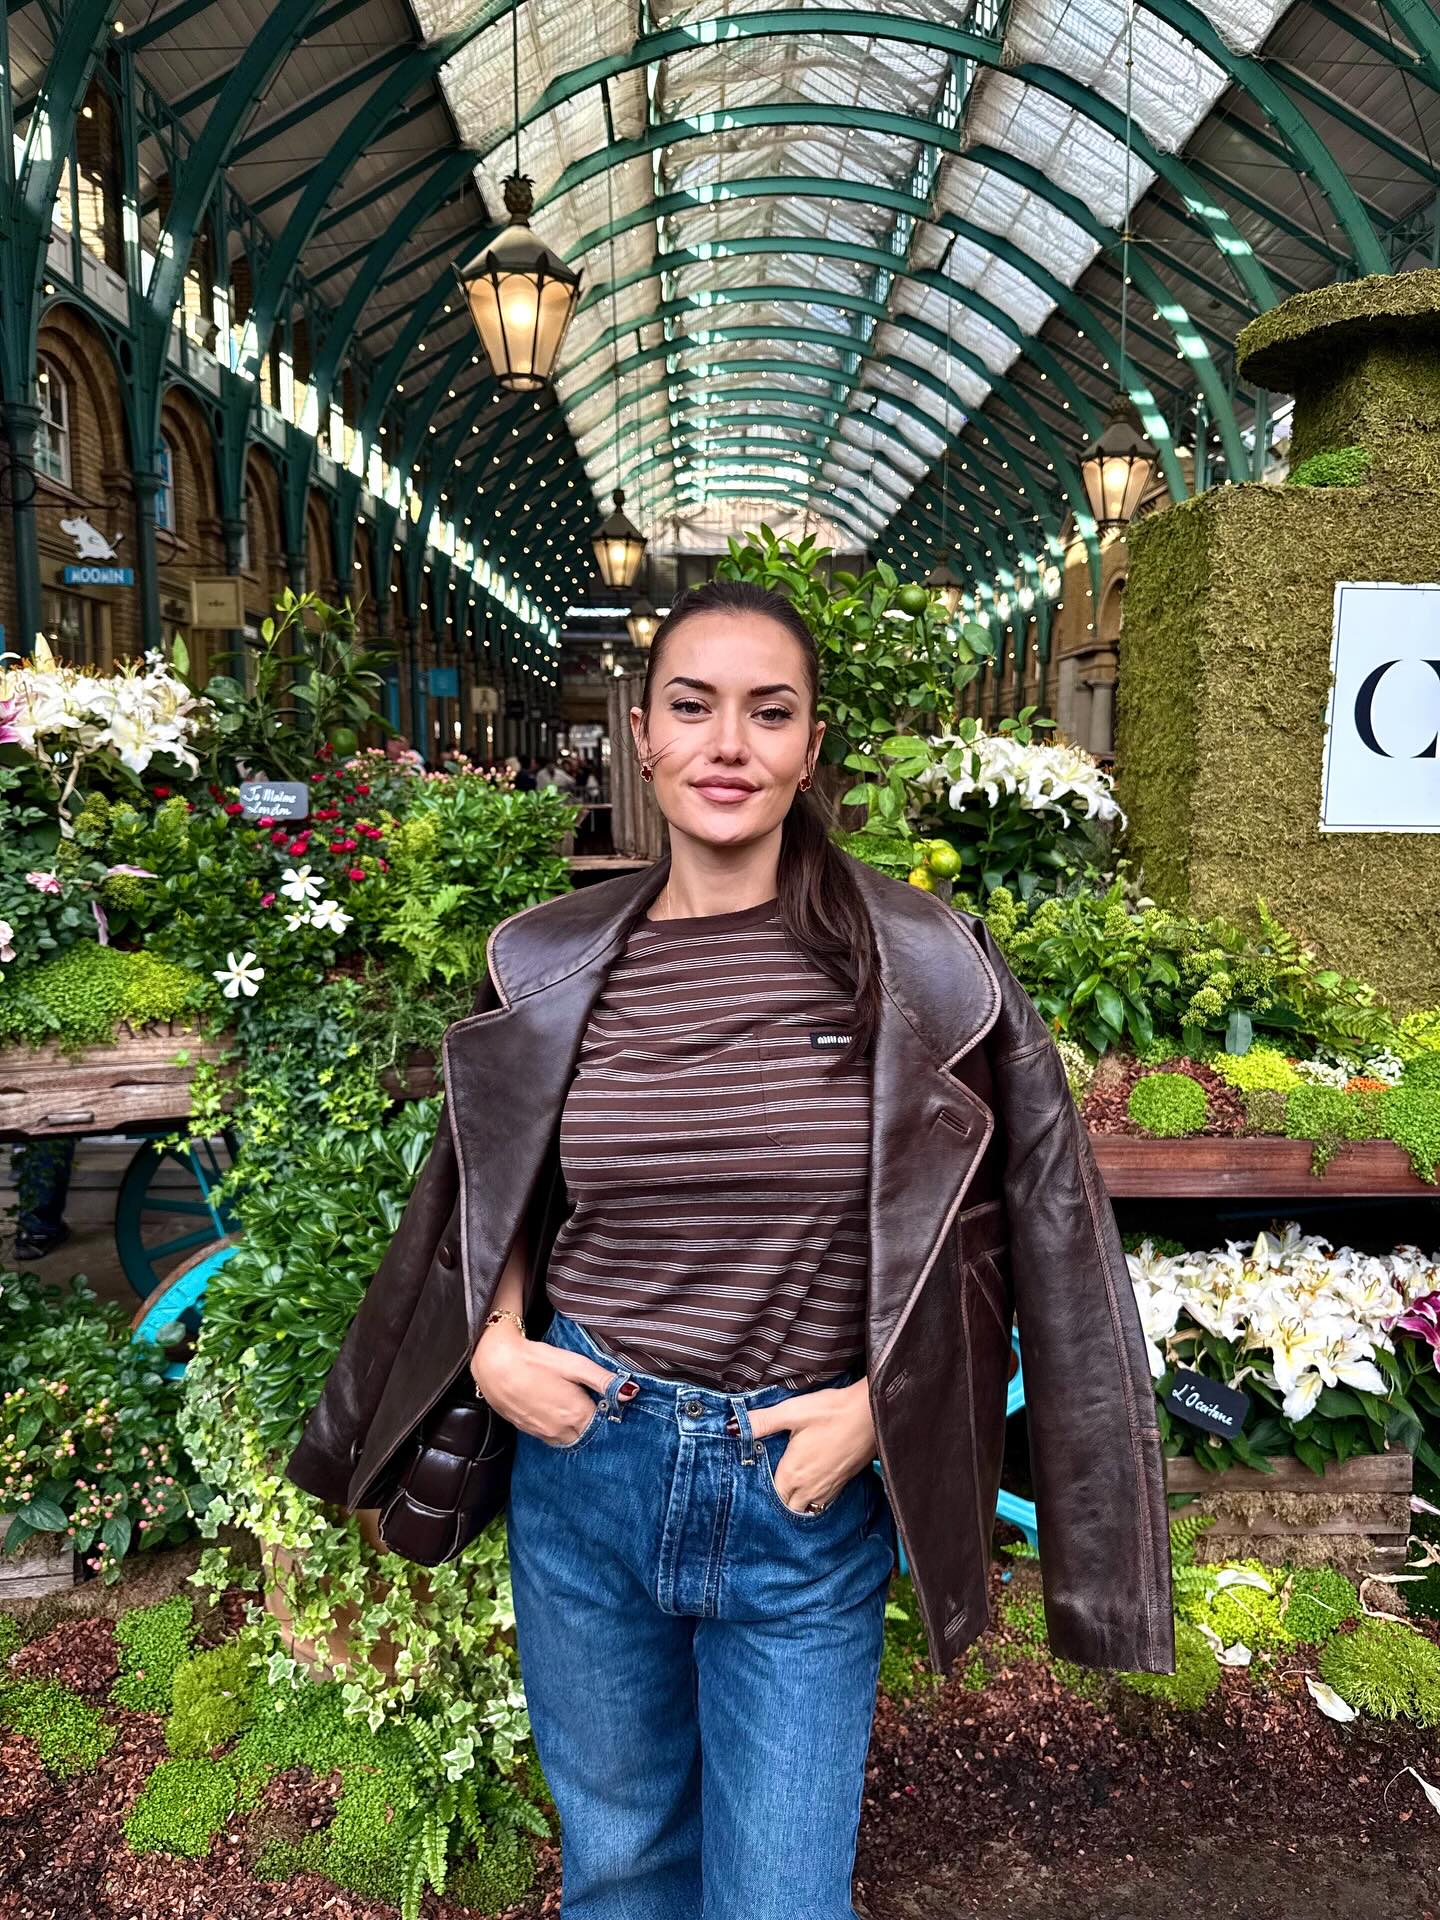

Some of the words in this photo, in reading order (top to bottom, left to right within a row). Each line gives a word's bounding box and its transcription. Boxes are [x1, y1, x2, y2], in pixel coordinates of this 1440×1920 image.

[71, 566, 124, 584] MOOMIN
[241, 785, 262, 802] Jo
[246, 801, 292, 816] London
